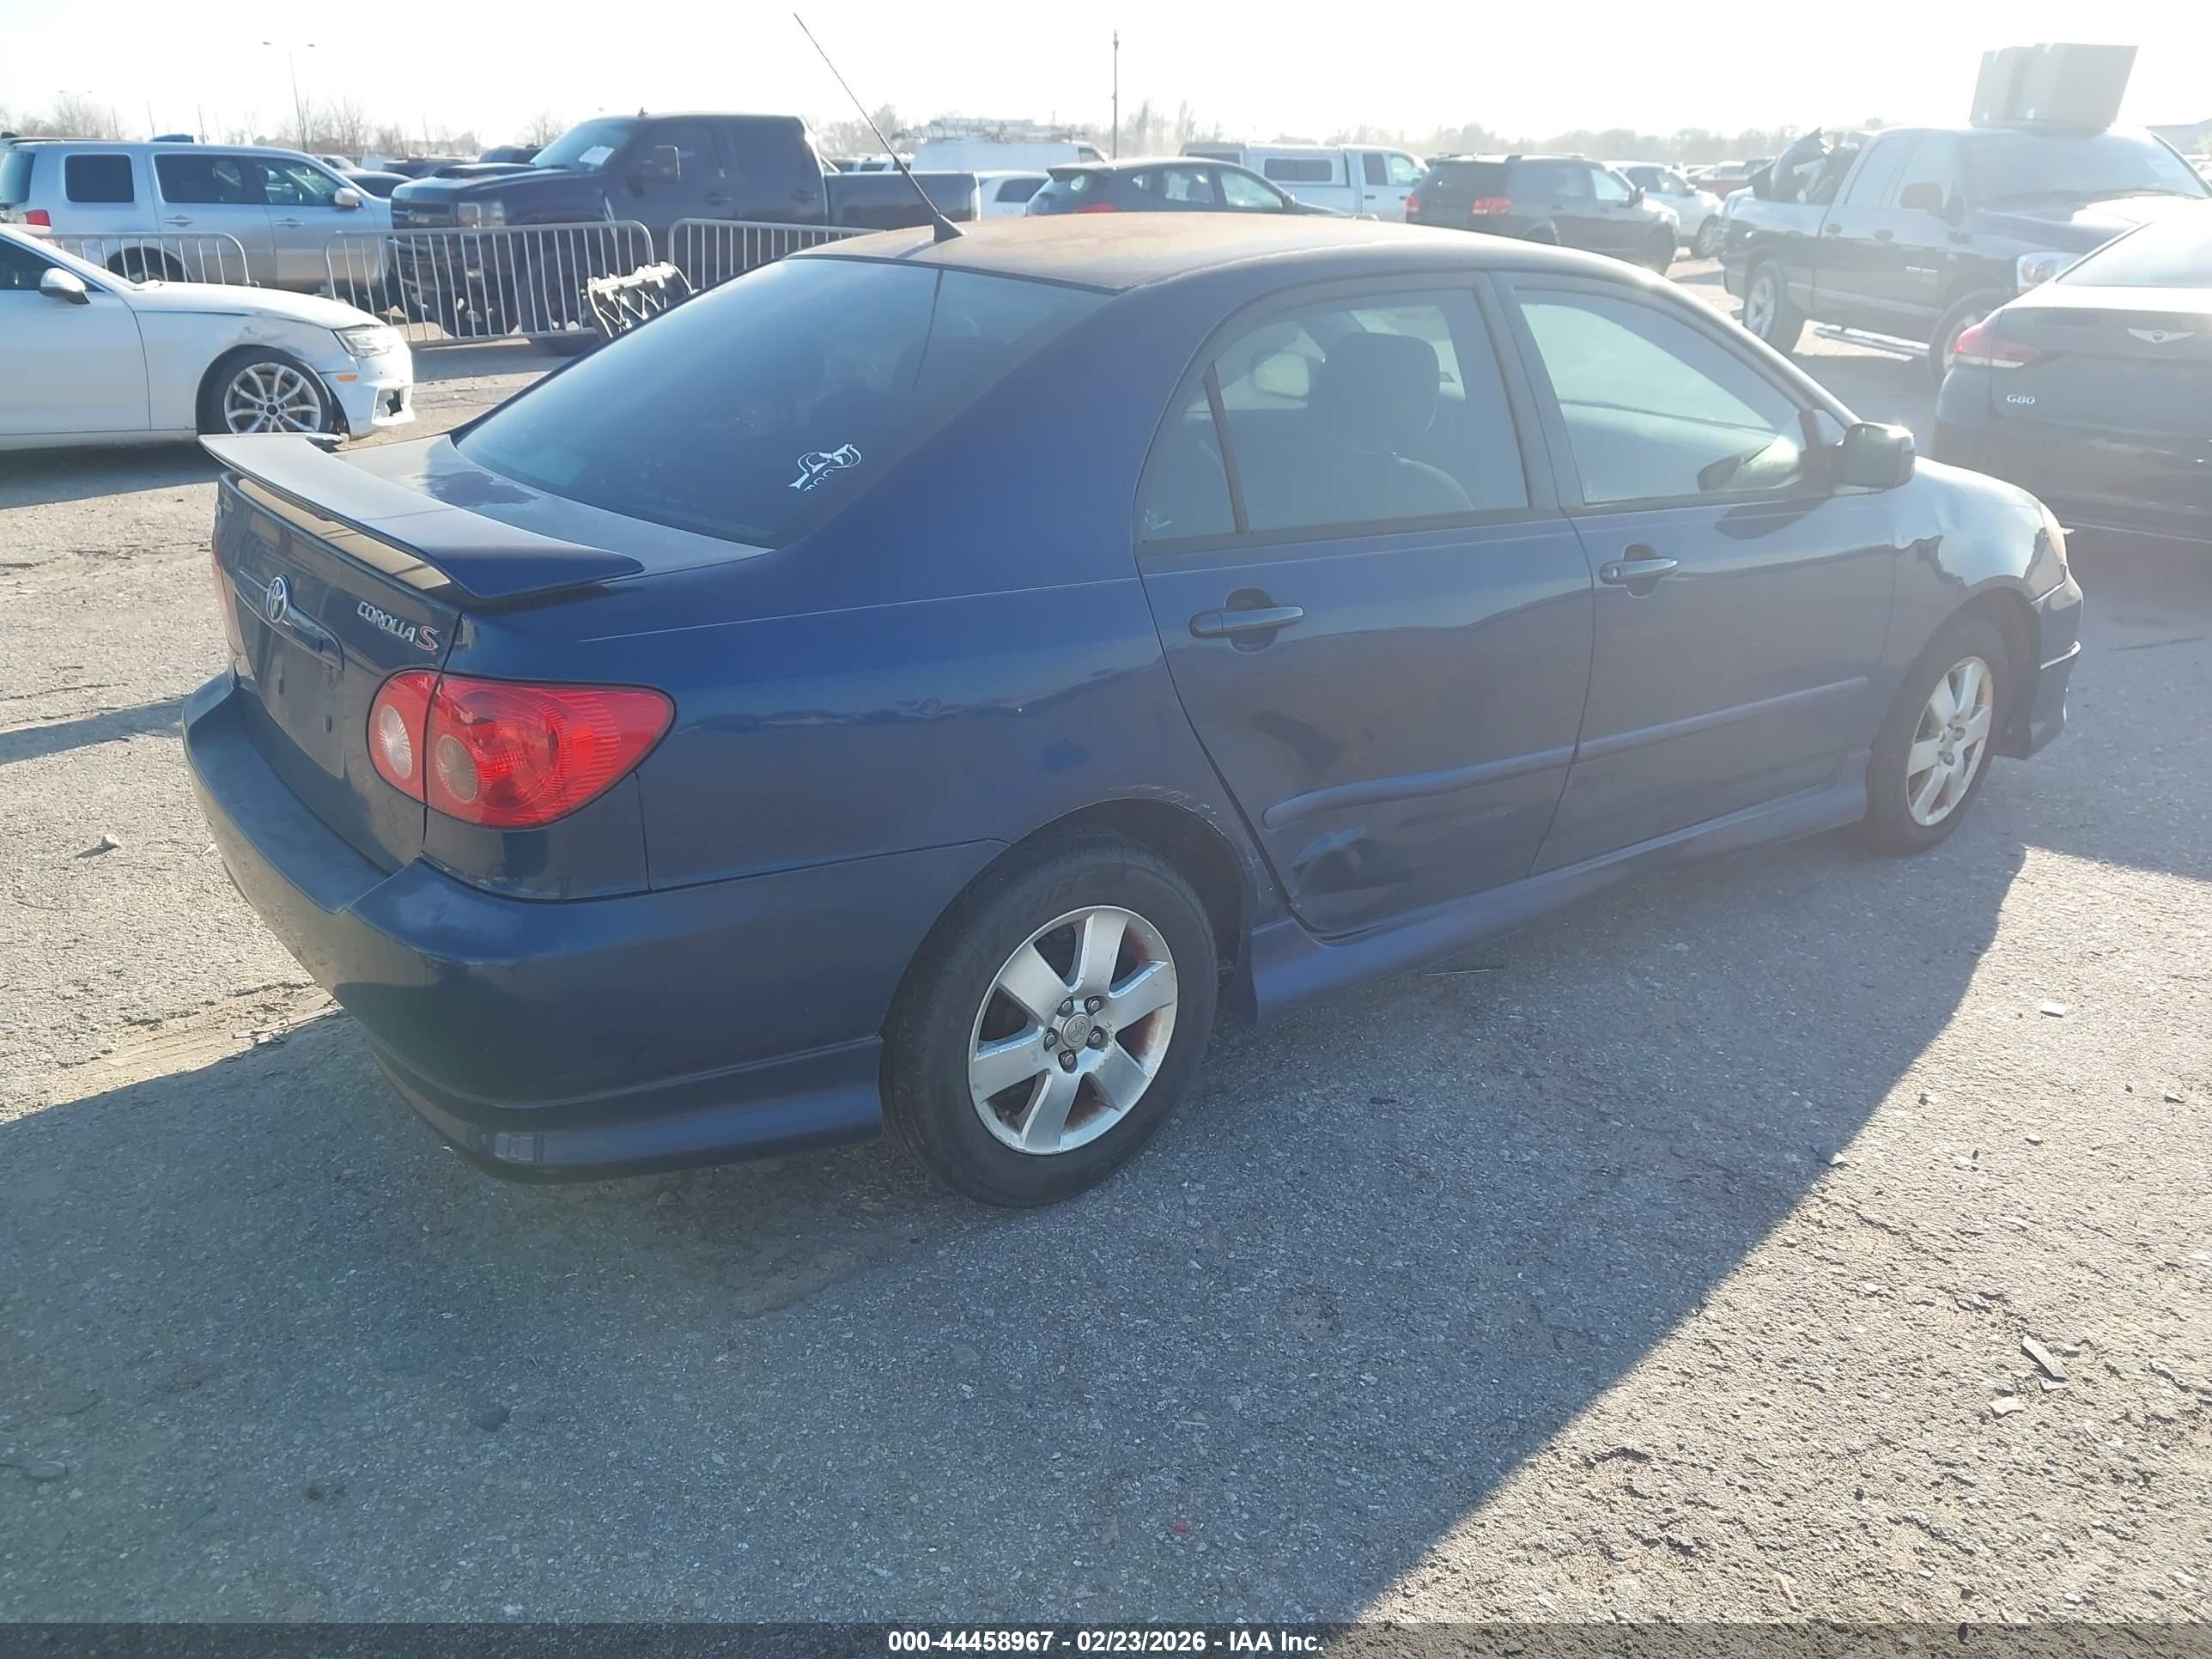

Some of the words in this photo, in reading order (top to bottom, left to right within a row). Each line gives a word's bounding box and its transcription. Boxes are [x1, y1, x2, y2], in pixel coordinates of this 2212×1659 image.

[2006, 393, 2036, 405] G80
[356, 601, 416, 642] COROLLA
[415, 625, 440, 652] S
